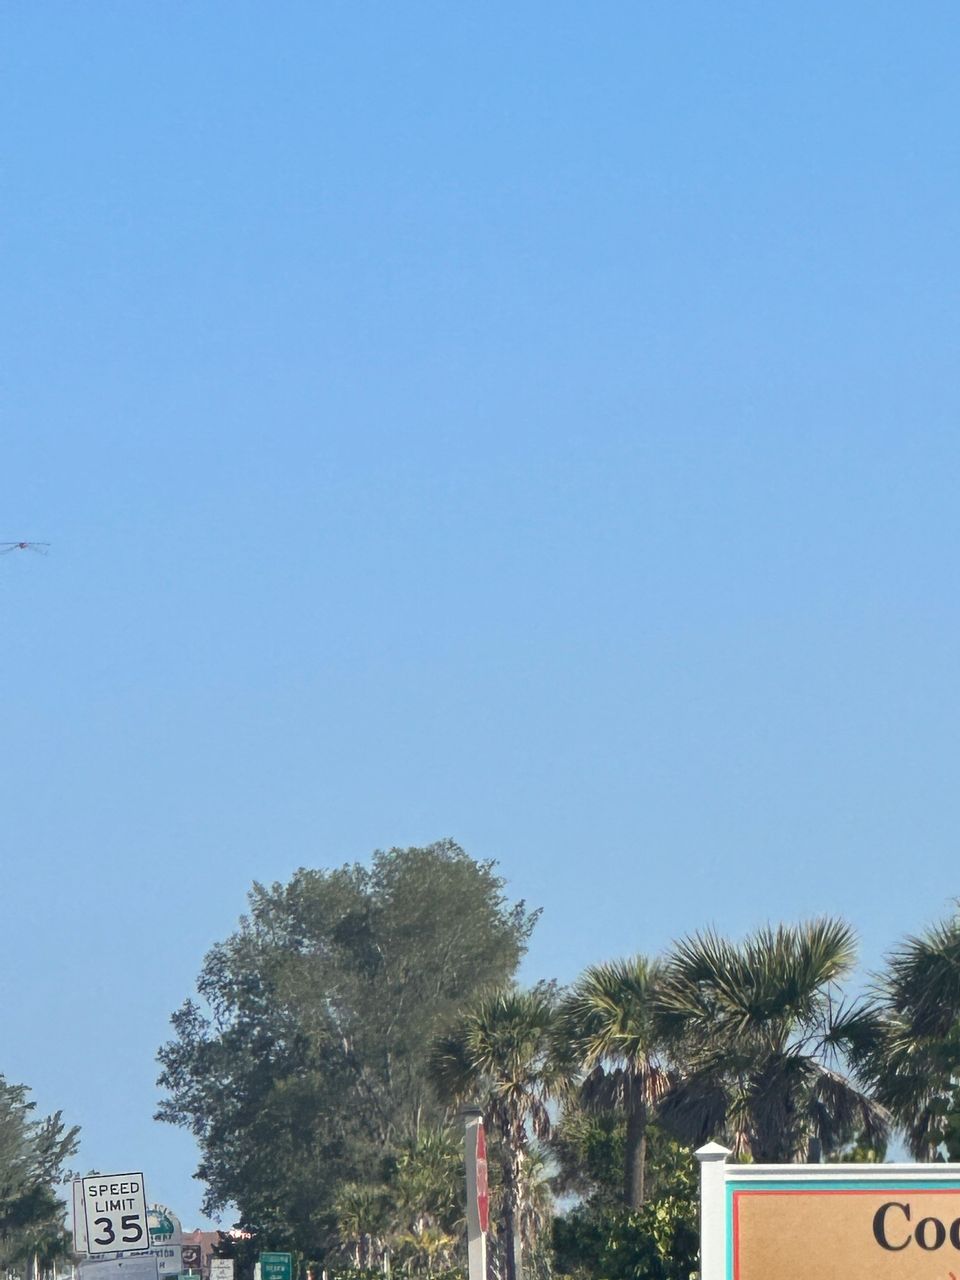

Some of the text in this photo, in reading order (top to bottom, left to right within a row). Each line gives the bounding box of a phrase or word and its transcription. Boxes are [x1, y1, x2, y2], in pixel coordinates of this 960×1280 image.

[88, 1182, 140, 1197] SPEED
[95, 1198, 136, 1213] LIMIT
[94, 1214, 143, 1245] 35
